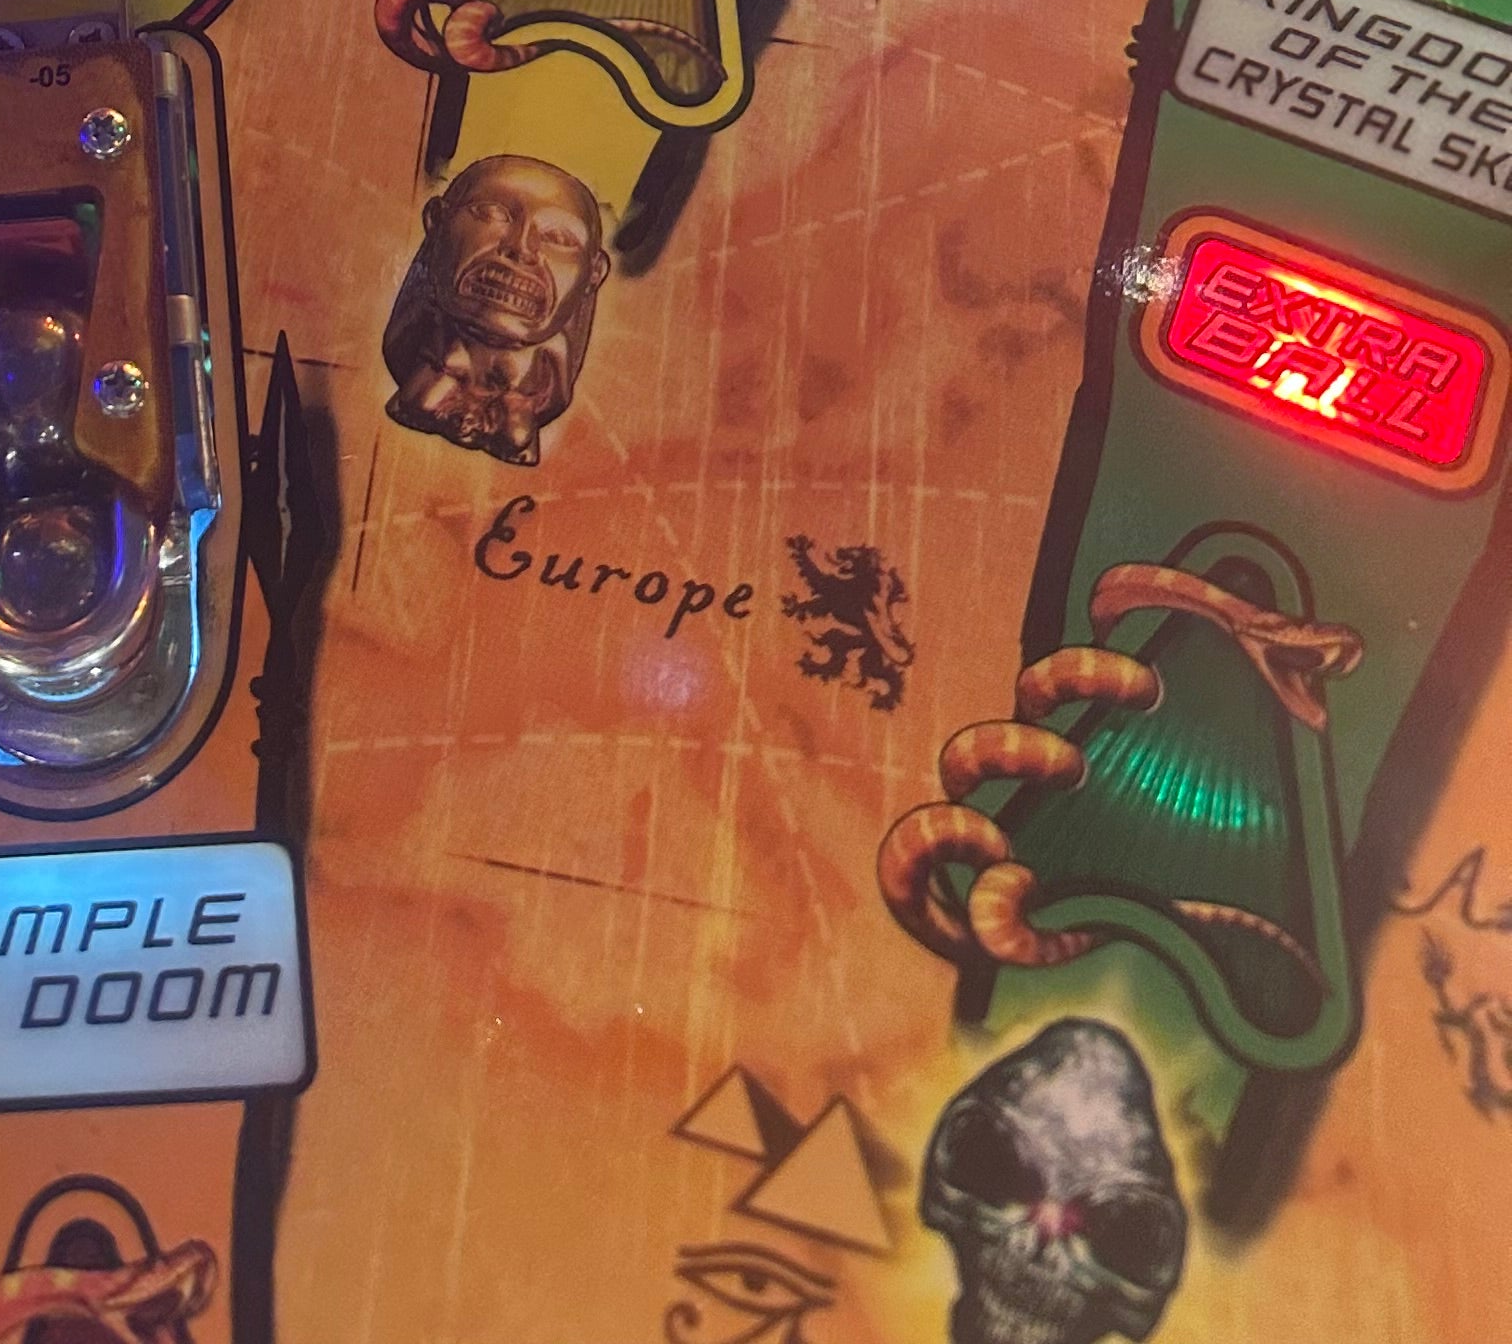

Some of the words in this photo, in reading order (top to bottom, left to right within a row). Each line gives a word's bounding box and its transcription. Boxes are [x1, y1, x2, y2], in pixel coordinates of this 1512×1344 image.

[1193, 46, 1414, 154] CRYSTAL
[1269, 27, 1371, 70] OF
[1390, 65, 1512, 135] THE
[1187, 310, 1429, 440] BALL
[1198, 262, 1461, 392] EXTRA
[473, 496, 756, 638] Europe
[20, 963, 282, 1030] DOOM
